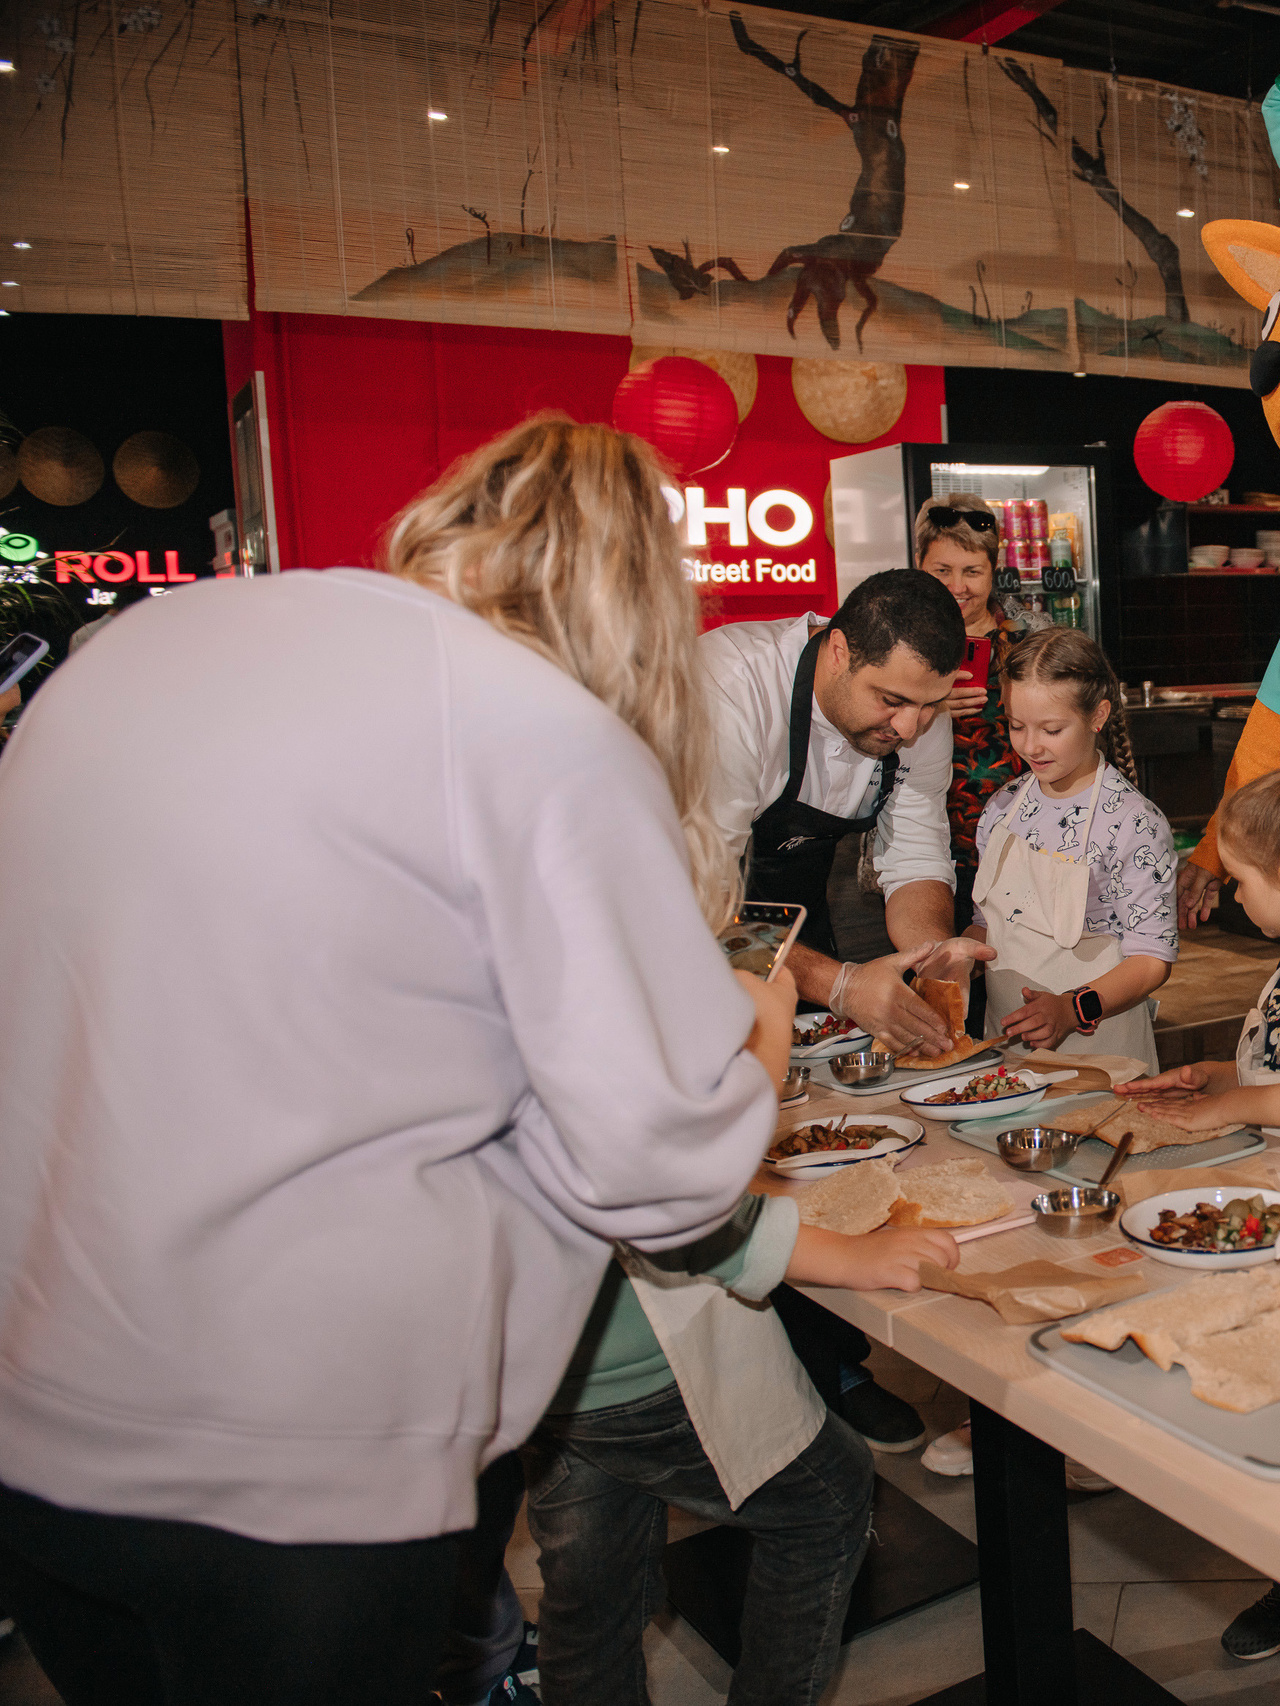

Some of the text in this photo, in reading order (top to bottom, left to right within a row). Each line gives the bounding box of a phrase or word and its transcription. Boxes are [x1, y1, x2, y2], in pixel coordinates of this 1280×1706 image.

[54, 550, 197, 583] ROLL
[681, 558, 816, 583] Street Food
